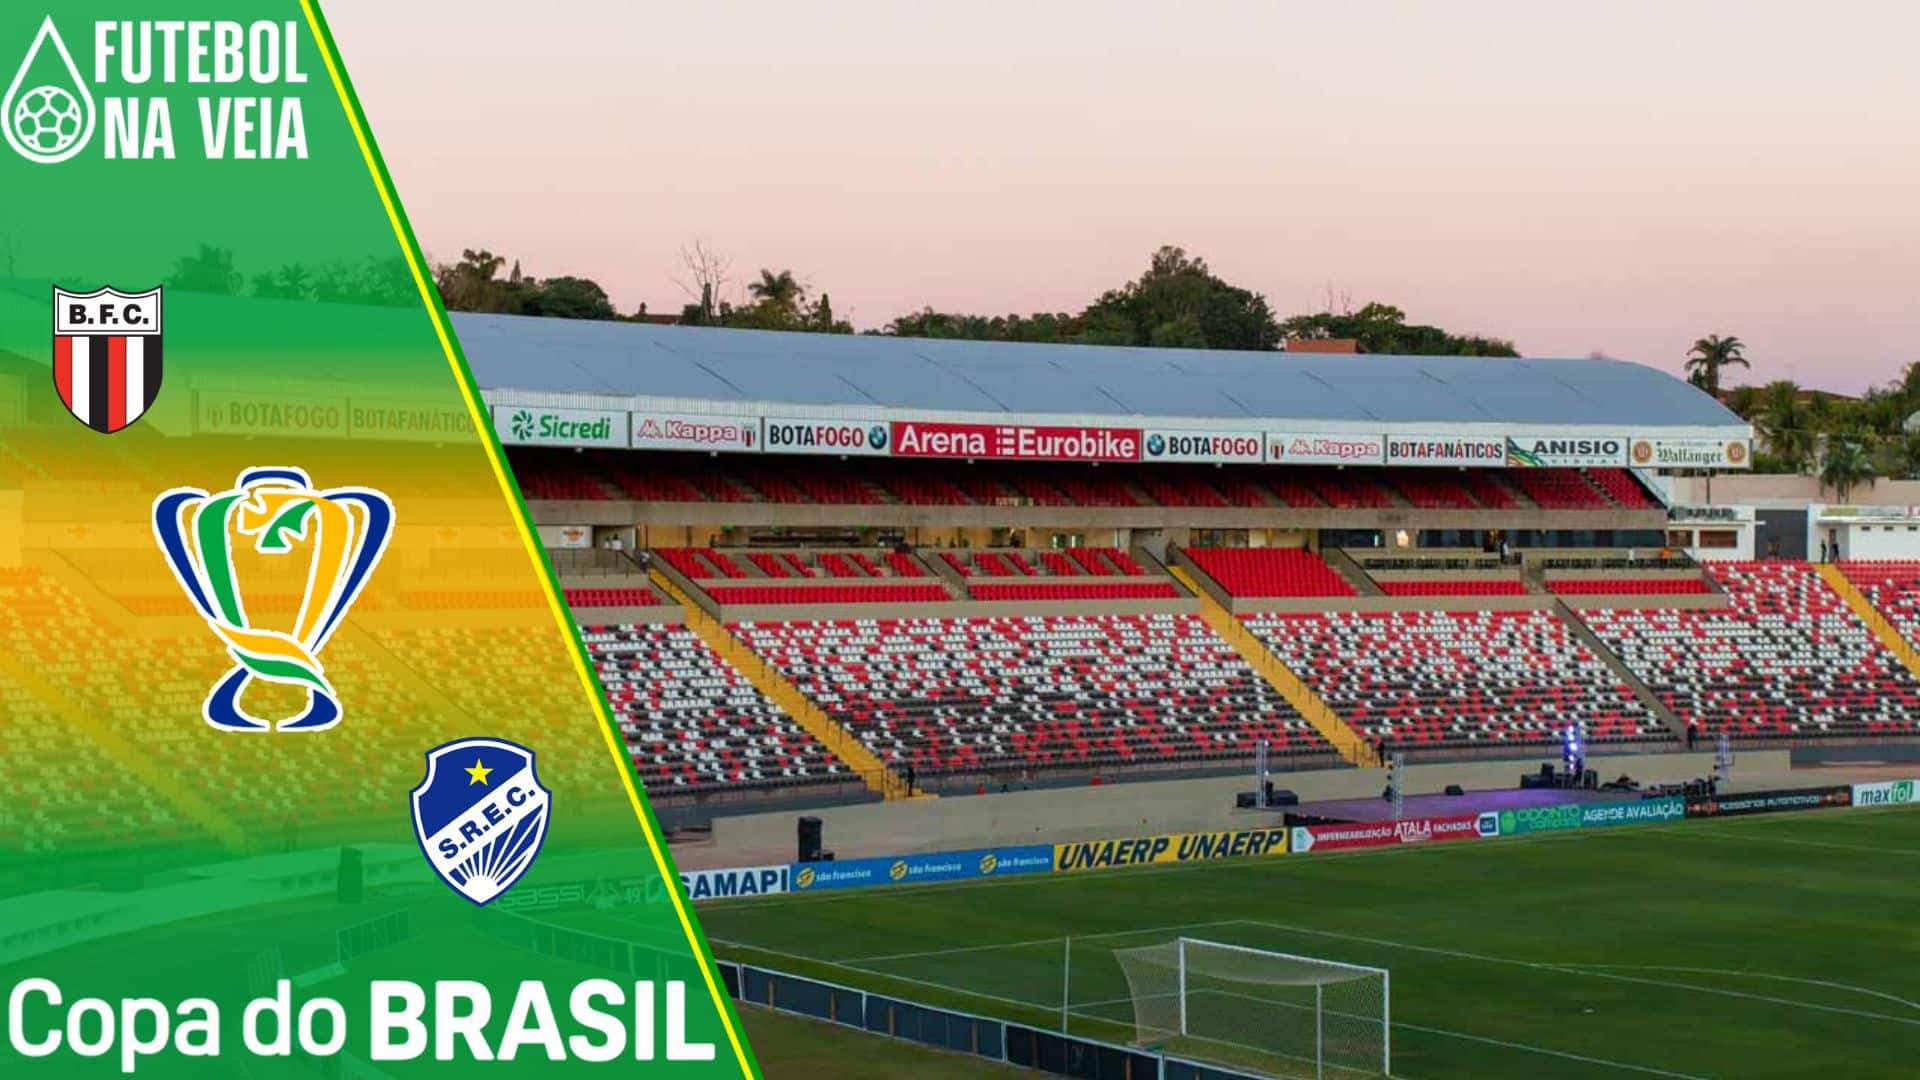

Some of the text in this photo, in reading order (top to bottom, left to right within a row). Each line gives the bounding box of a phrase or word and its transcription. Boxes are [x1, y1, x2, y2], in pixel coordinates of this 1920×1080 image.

[230, 402, 340, 428] BOTAFOGO
[353, 407, 476, 433] BOTAFANÁTICO
[539, 415, 611, 440] Sicredi
[665, 421, 737, 442] Kappa
[769, 424, 864, 448] BOTAFOGO
[899, 425, 1136, 458] Arena Eurobike
[1169, 436, 1259, 456] BOTAFOGO
[1313, 439, 1380, 458] Kappa
[1389, 439, 1503, 460] BOTAFANÁTICOS
[1532, 440, 1620, 455] ANISIO
[1583, 807, 1625, 822] AGENDE
[1626, 802, 1684, 819] AVALIAÇÃO
[1058, 829, 1284, 870] UNAERP UNAERP
